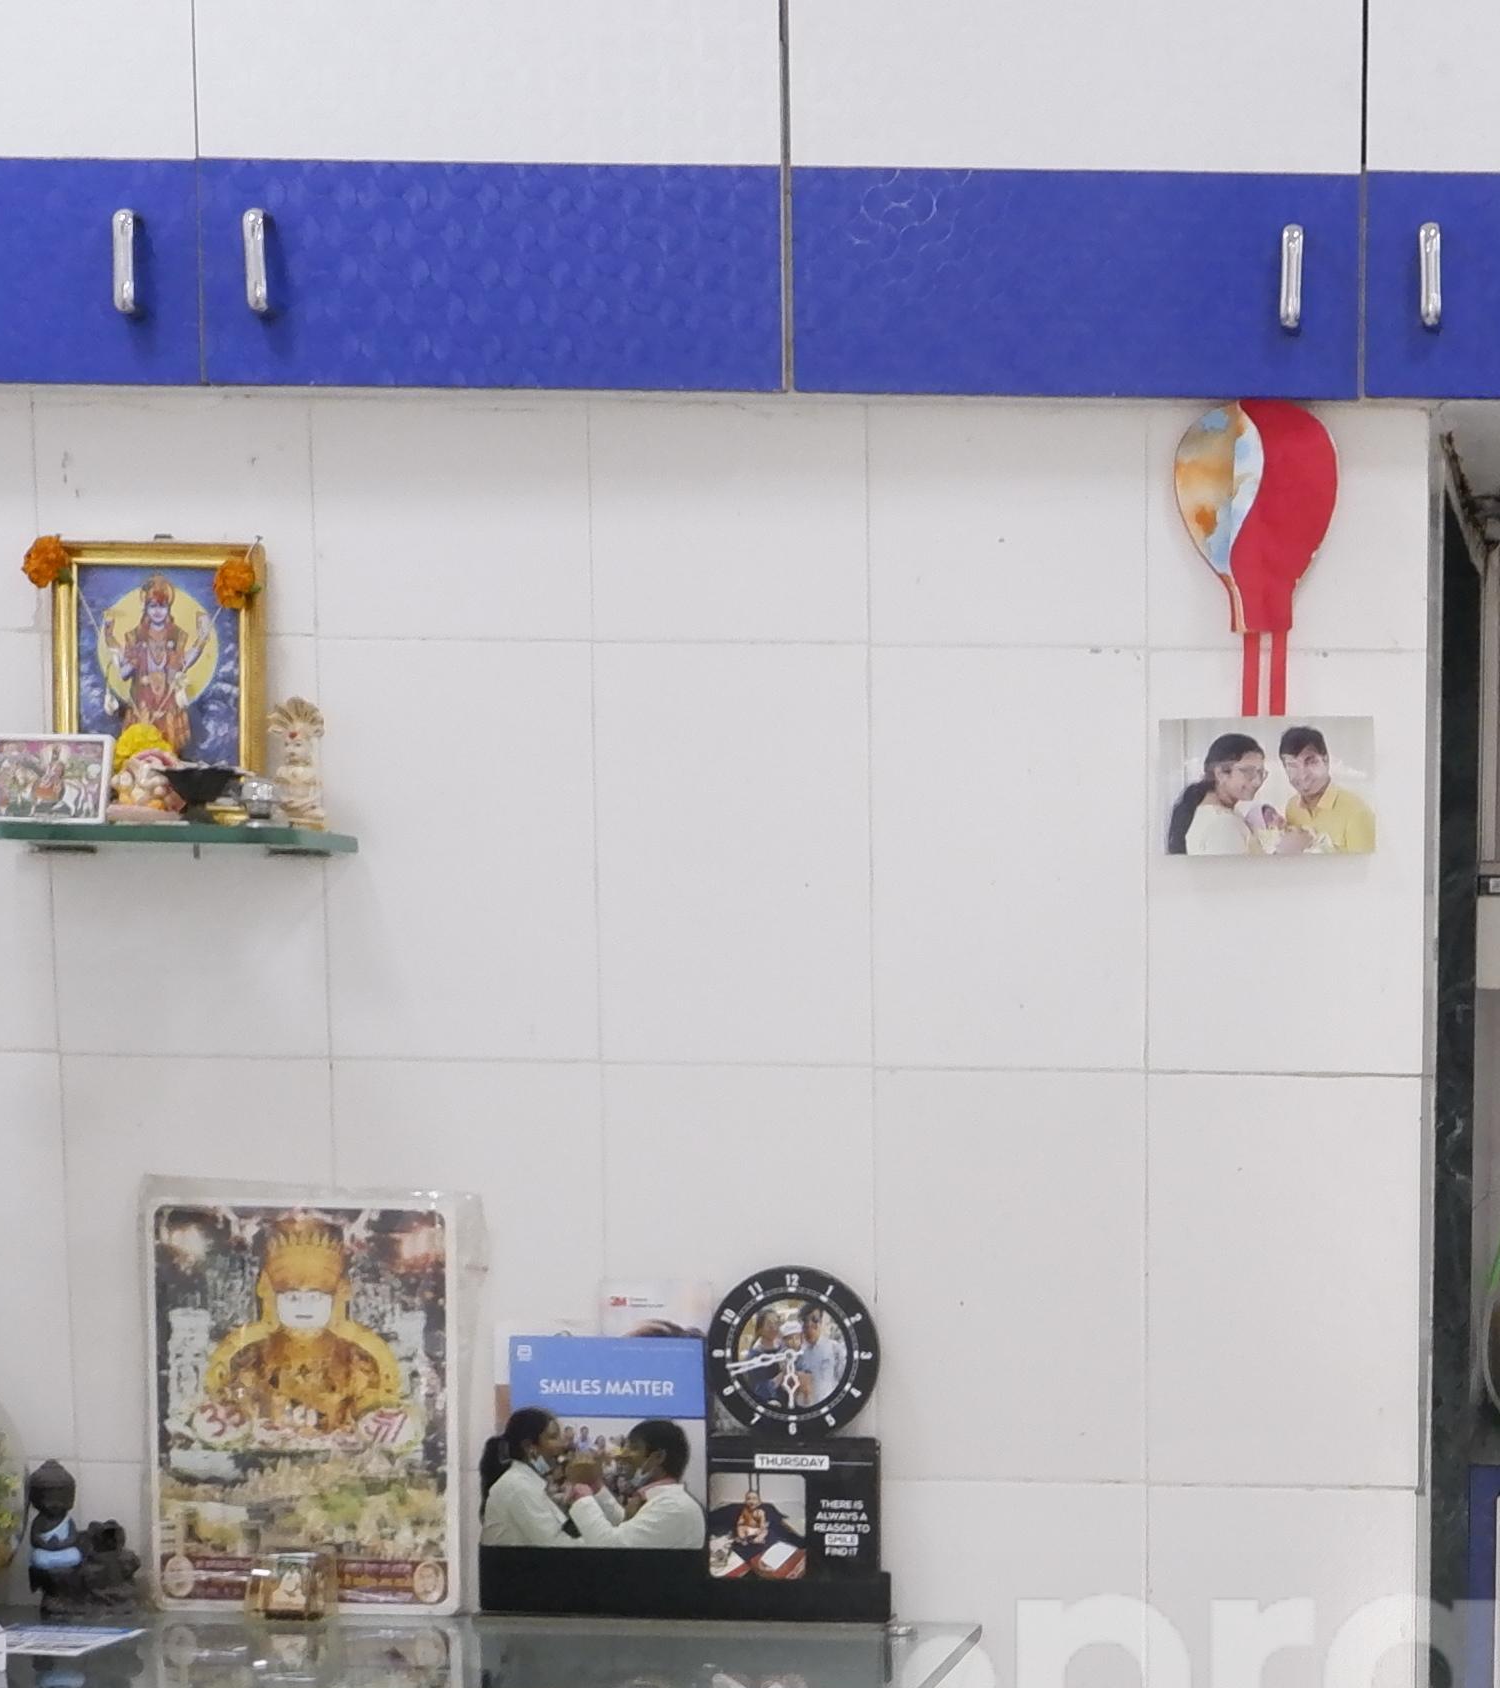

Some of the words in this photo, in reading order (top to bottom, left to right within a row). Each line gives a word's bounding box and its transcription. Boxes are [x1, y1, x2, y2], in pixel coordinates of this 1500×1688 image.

[785, 1273, 800, 1287] 12
[748, 1281, 764, 1297] 11
[825, 1284, 835, 1297] 1
[720, 1308, 737, 1324] 10
[850, 1312, 863, 1323] 2
[860, 1351, 873, 1361] 3
[539, 1378, 601, 1396] SMILES
[605, 1379, 675, 1397] MATTER
[850, 1387, 863, 1399] 4
[750, 1413, 762, 1425] 7
[788, 1422, 798, 1436] 6
[757, 1455, 826, 1468] THURSDAY
[819, 1499, 851, 1511] THERE
[852, 1500, 864, 1511] IS
[815, 1511, 859, 1523] ALWAYS
[859, 1512, 869, 1522] A
[813, 1523, 856, 1534] REASON
[857, 1523, 871, 1534] TO
[826, 1535, 857, 1545] SMILE
[824, 1547, 847, 1557] FIND
[848, 1547, 858, 1557] IT
